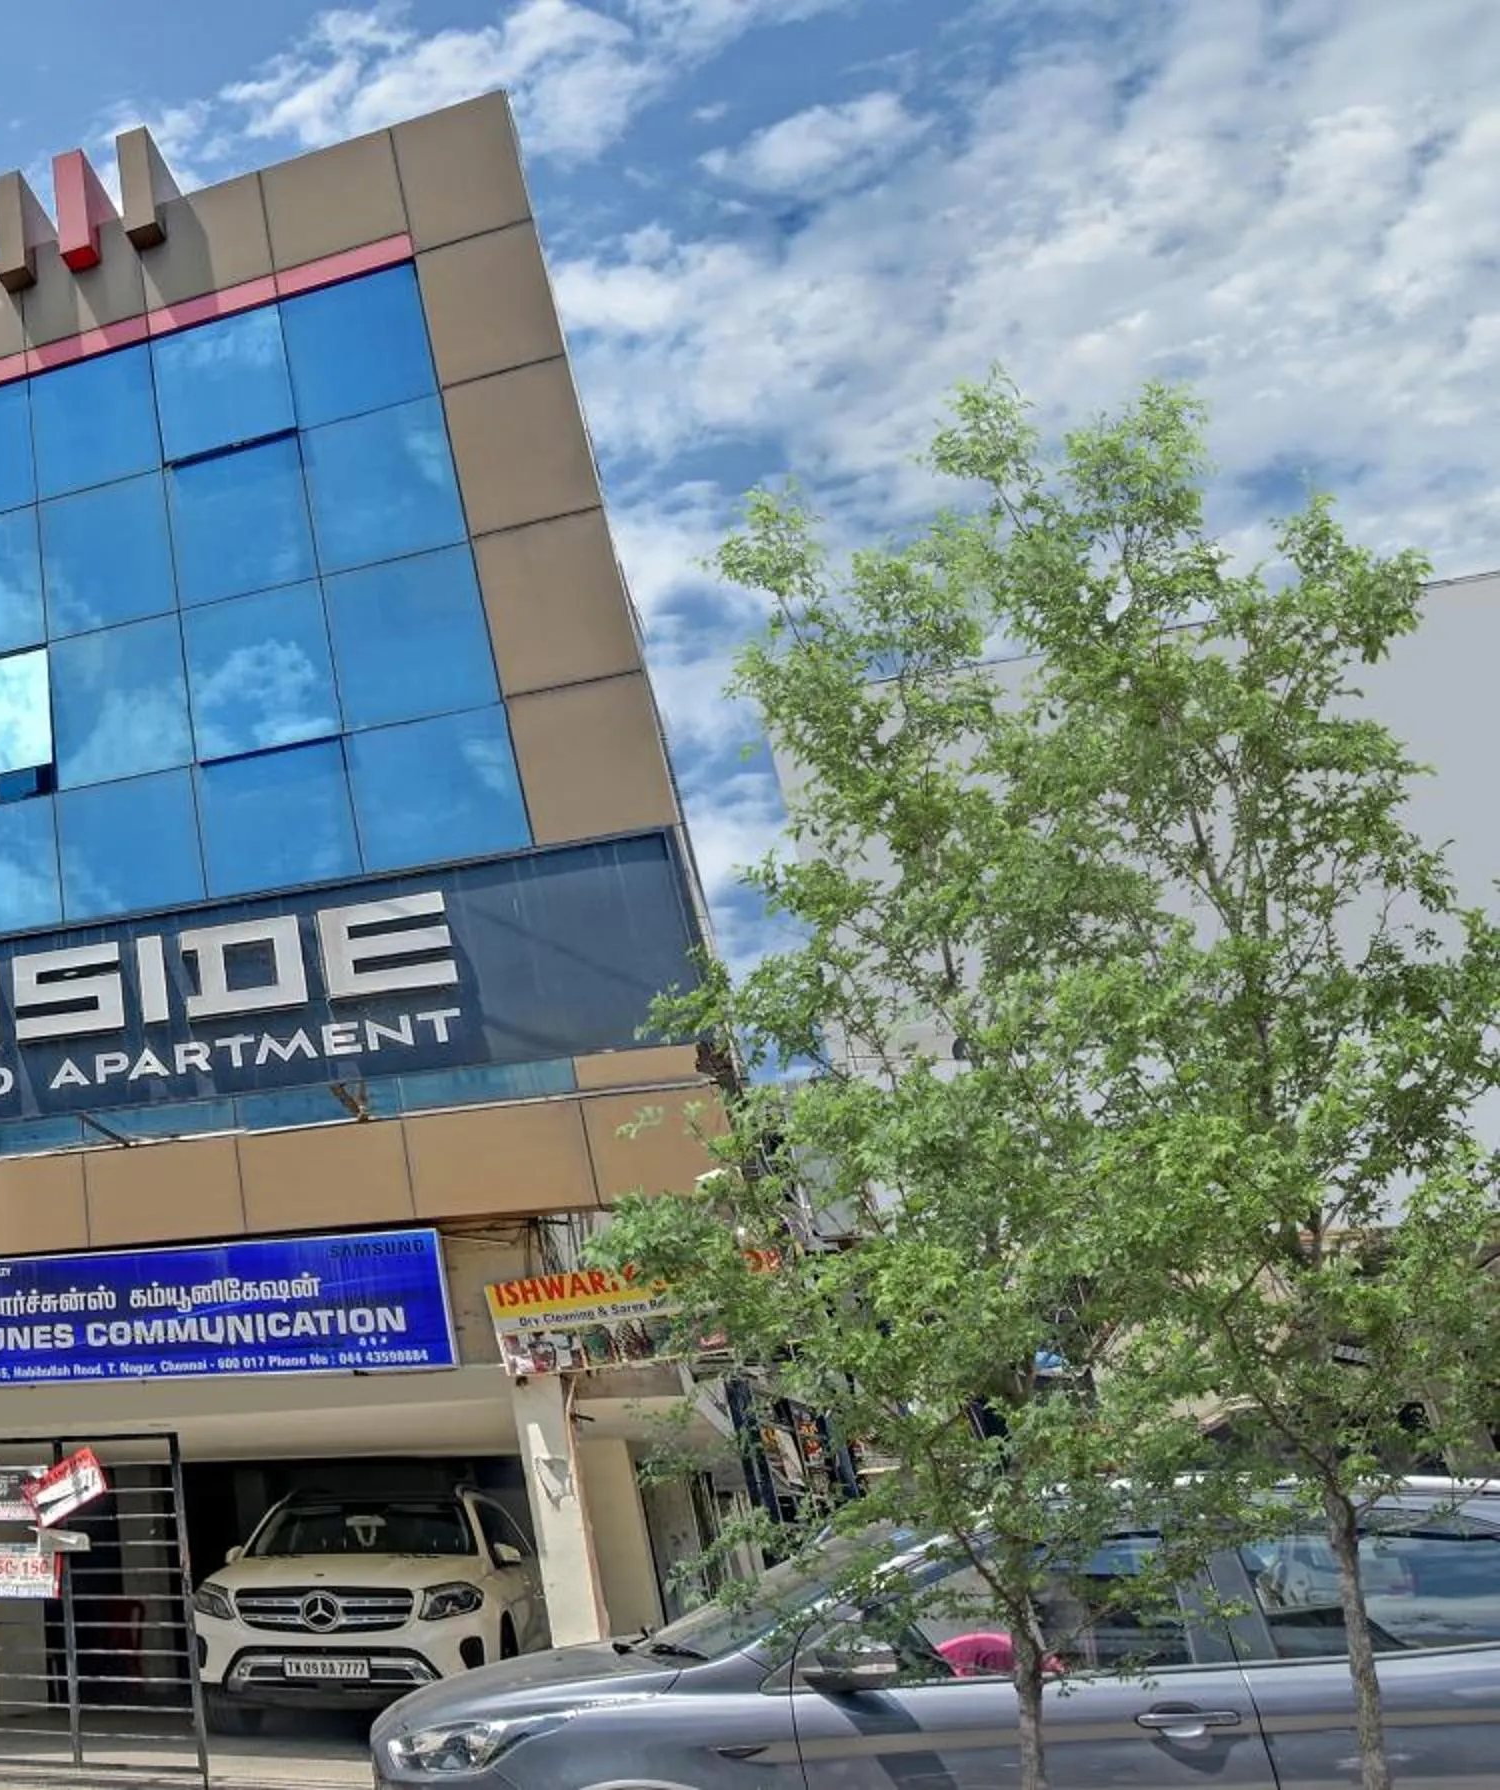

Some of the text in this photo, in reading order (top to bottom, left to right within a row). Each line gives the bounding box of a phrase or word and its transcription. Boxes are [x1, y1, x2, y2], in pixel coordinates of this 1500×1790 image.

[50, 1007, 460, 1090] APARTMENT
[328, 1239, 425, 1259] SAMSUNG
[86, 1306, 407, 1348] COMMUNICATION
[519, 1315, 540, 1329] Dry
[544, 1309, 595, 1325] Cleaning
[597, 1306, 609, 1318] &
[161, 1358, 208, 1373] Chennai
[218, 1356, 242, 1371] 600
[243, 1355, 264, 1369] 017
[268, 1354, 307, 1368] Phone
